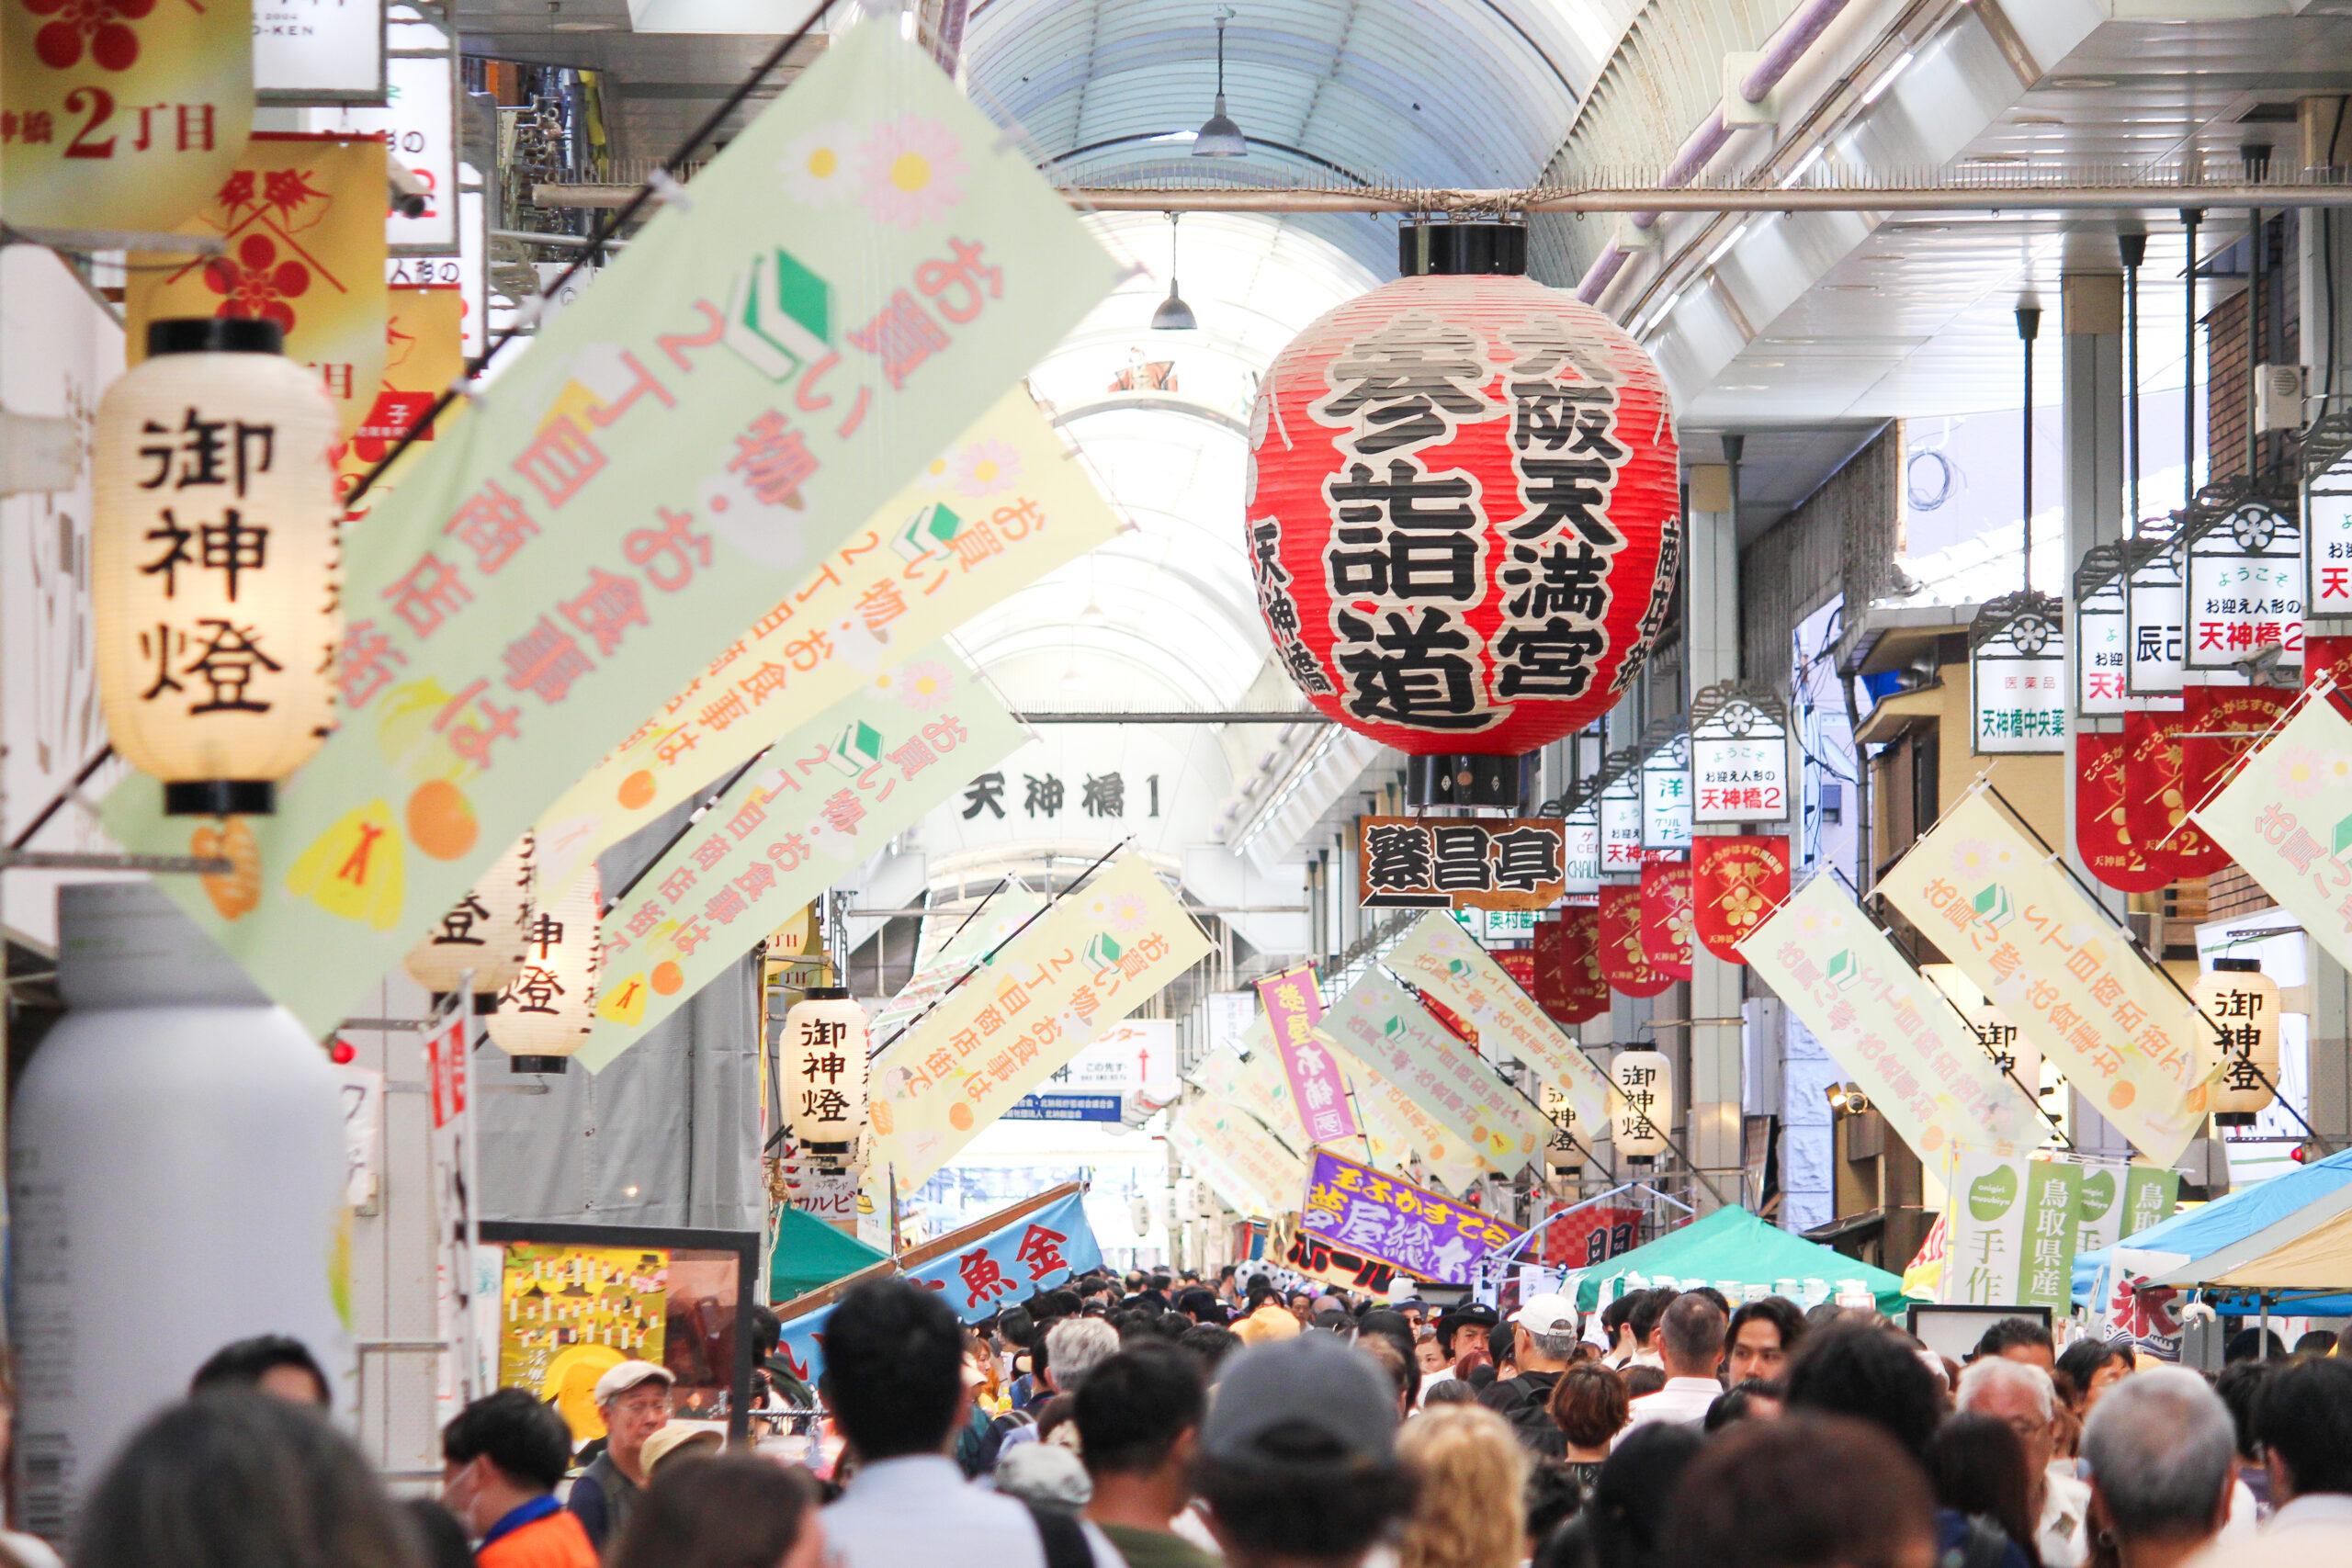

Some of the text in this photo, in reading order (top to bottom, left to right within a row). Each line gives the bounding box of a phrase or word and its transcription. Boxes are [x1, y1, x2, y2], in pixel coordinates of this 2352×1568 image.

[333, 299, 727, 728] 2丁目商店街
[432, 237, 1004, 769] お買い物・お食事は
[1498, 319, 1625, 697] 大阪天満宮
[137, 407, 284, 715] 御神燈
[2218, 566, 2290, 588] ようこそ
[655, 497, 1049, 766] お買い物・お食事は
[2199, 621, 2303, 652] 天神橋2
[2205, 598, 2301, 615] お迎え人形の
[2005, 676, 2056, 690] 医薬品
[1713, 747, 1765, 762] ようこそ
[1982, 707, 2064, 739] 天神橋中央薬
[1658, 777, 1684, 798] 洋
[1701, 786, 1781, 809] 天神橋2
[1705, 770, 1775, 782] お迎え人形の
[676, 713, 967, 955] お買い物・お食事は
[1367, 825, 1563, 893] 繁昌亭
[903, 949, 1074, 1100] 2丁目商店街で
[963, 931, 1172, 1102] お買い物・お食事は
[800, 1018, 851, 1122] 御神燈
[1622, 1065, 1657, 1141] 御神燈
[1977, 1184, 2006, 1194] onigiri
[1964, 1228, 2006, 1305] 手作
